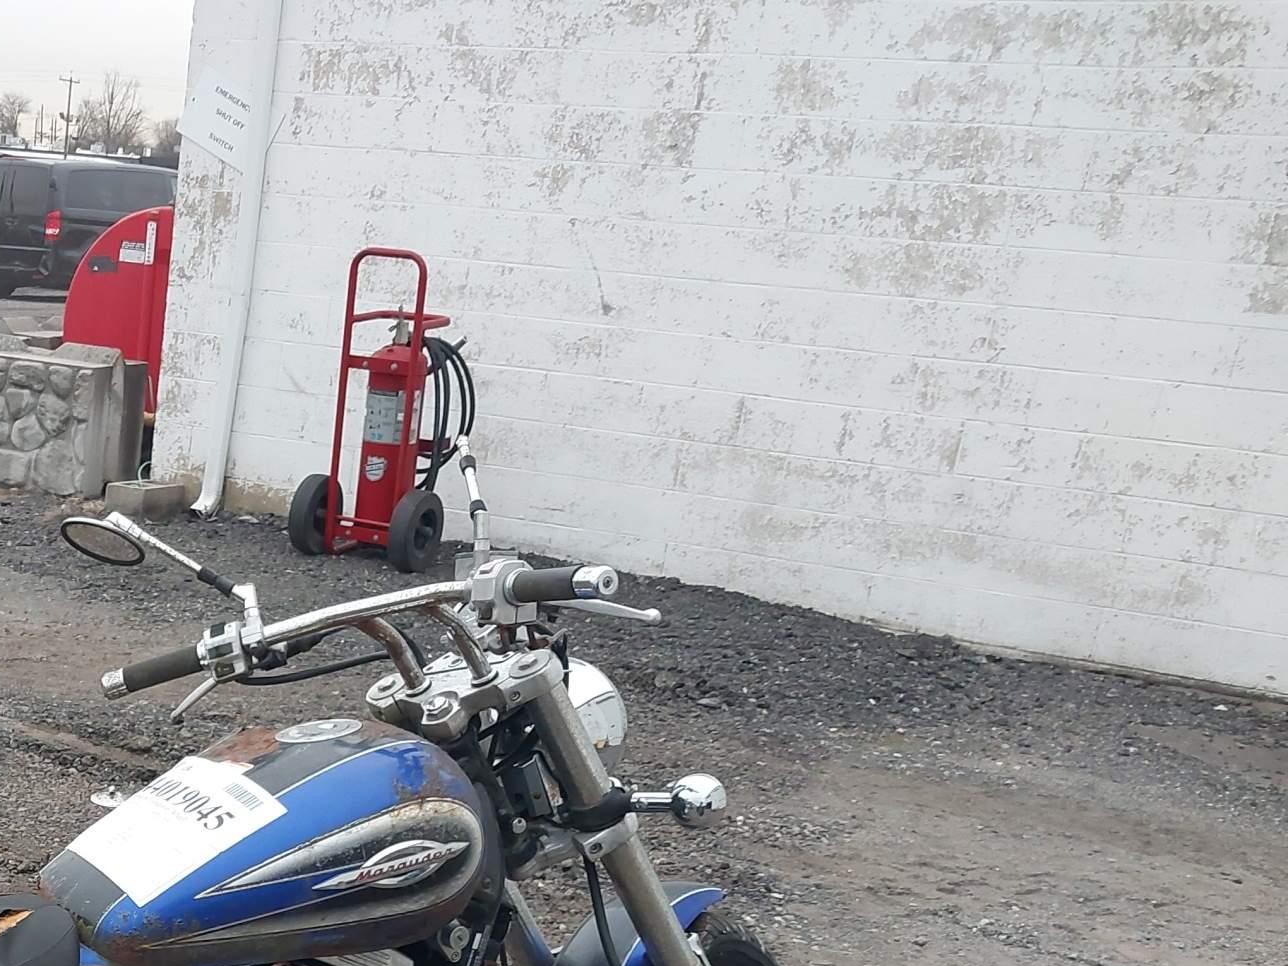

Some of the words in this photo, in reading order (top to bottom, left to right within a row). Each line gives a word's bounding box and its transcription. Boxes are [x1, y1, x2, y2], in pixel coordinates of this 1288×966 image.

[215, 86, 250, 112] EMERGENC
[215, 108, 232, 122] SHUT
[232, 118, 245, 130] OFF
[208, 132, 234, 152] SWITCH
